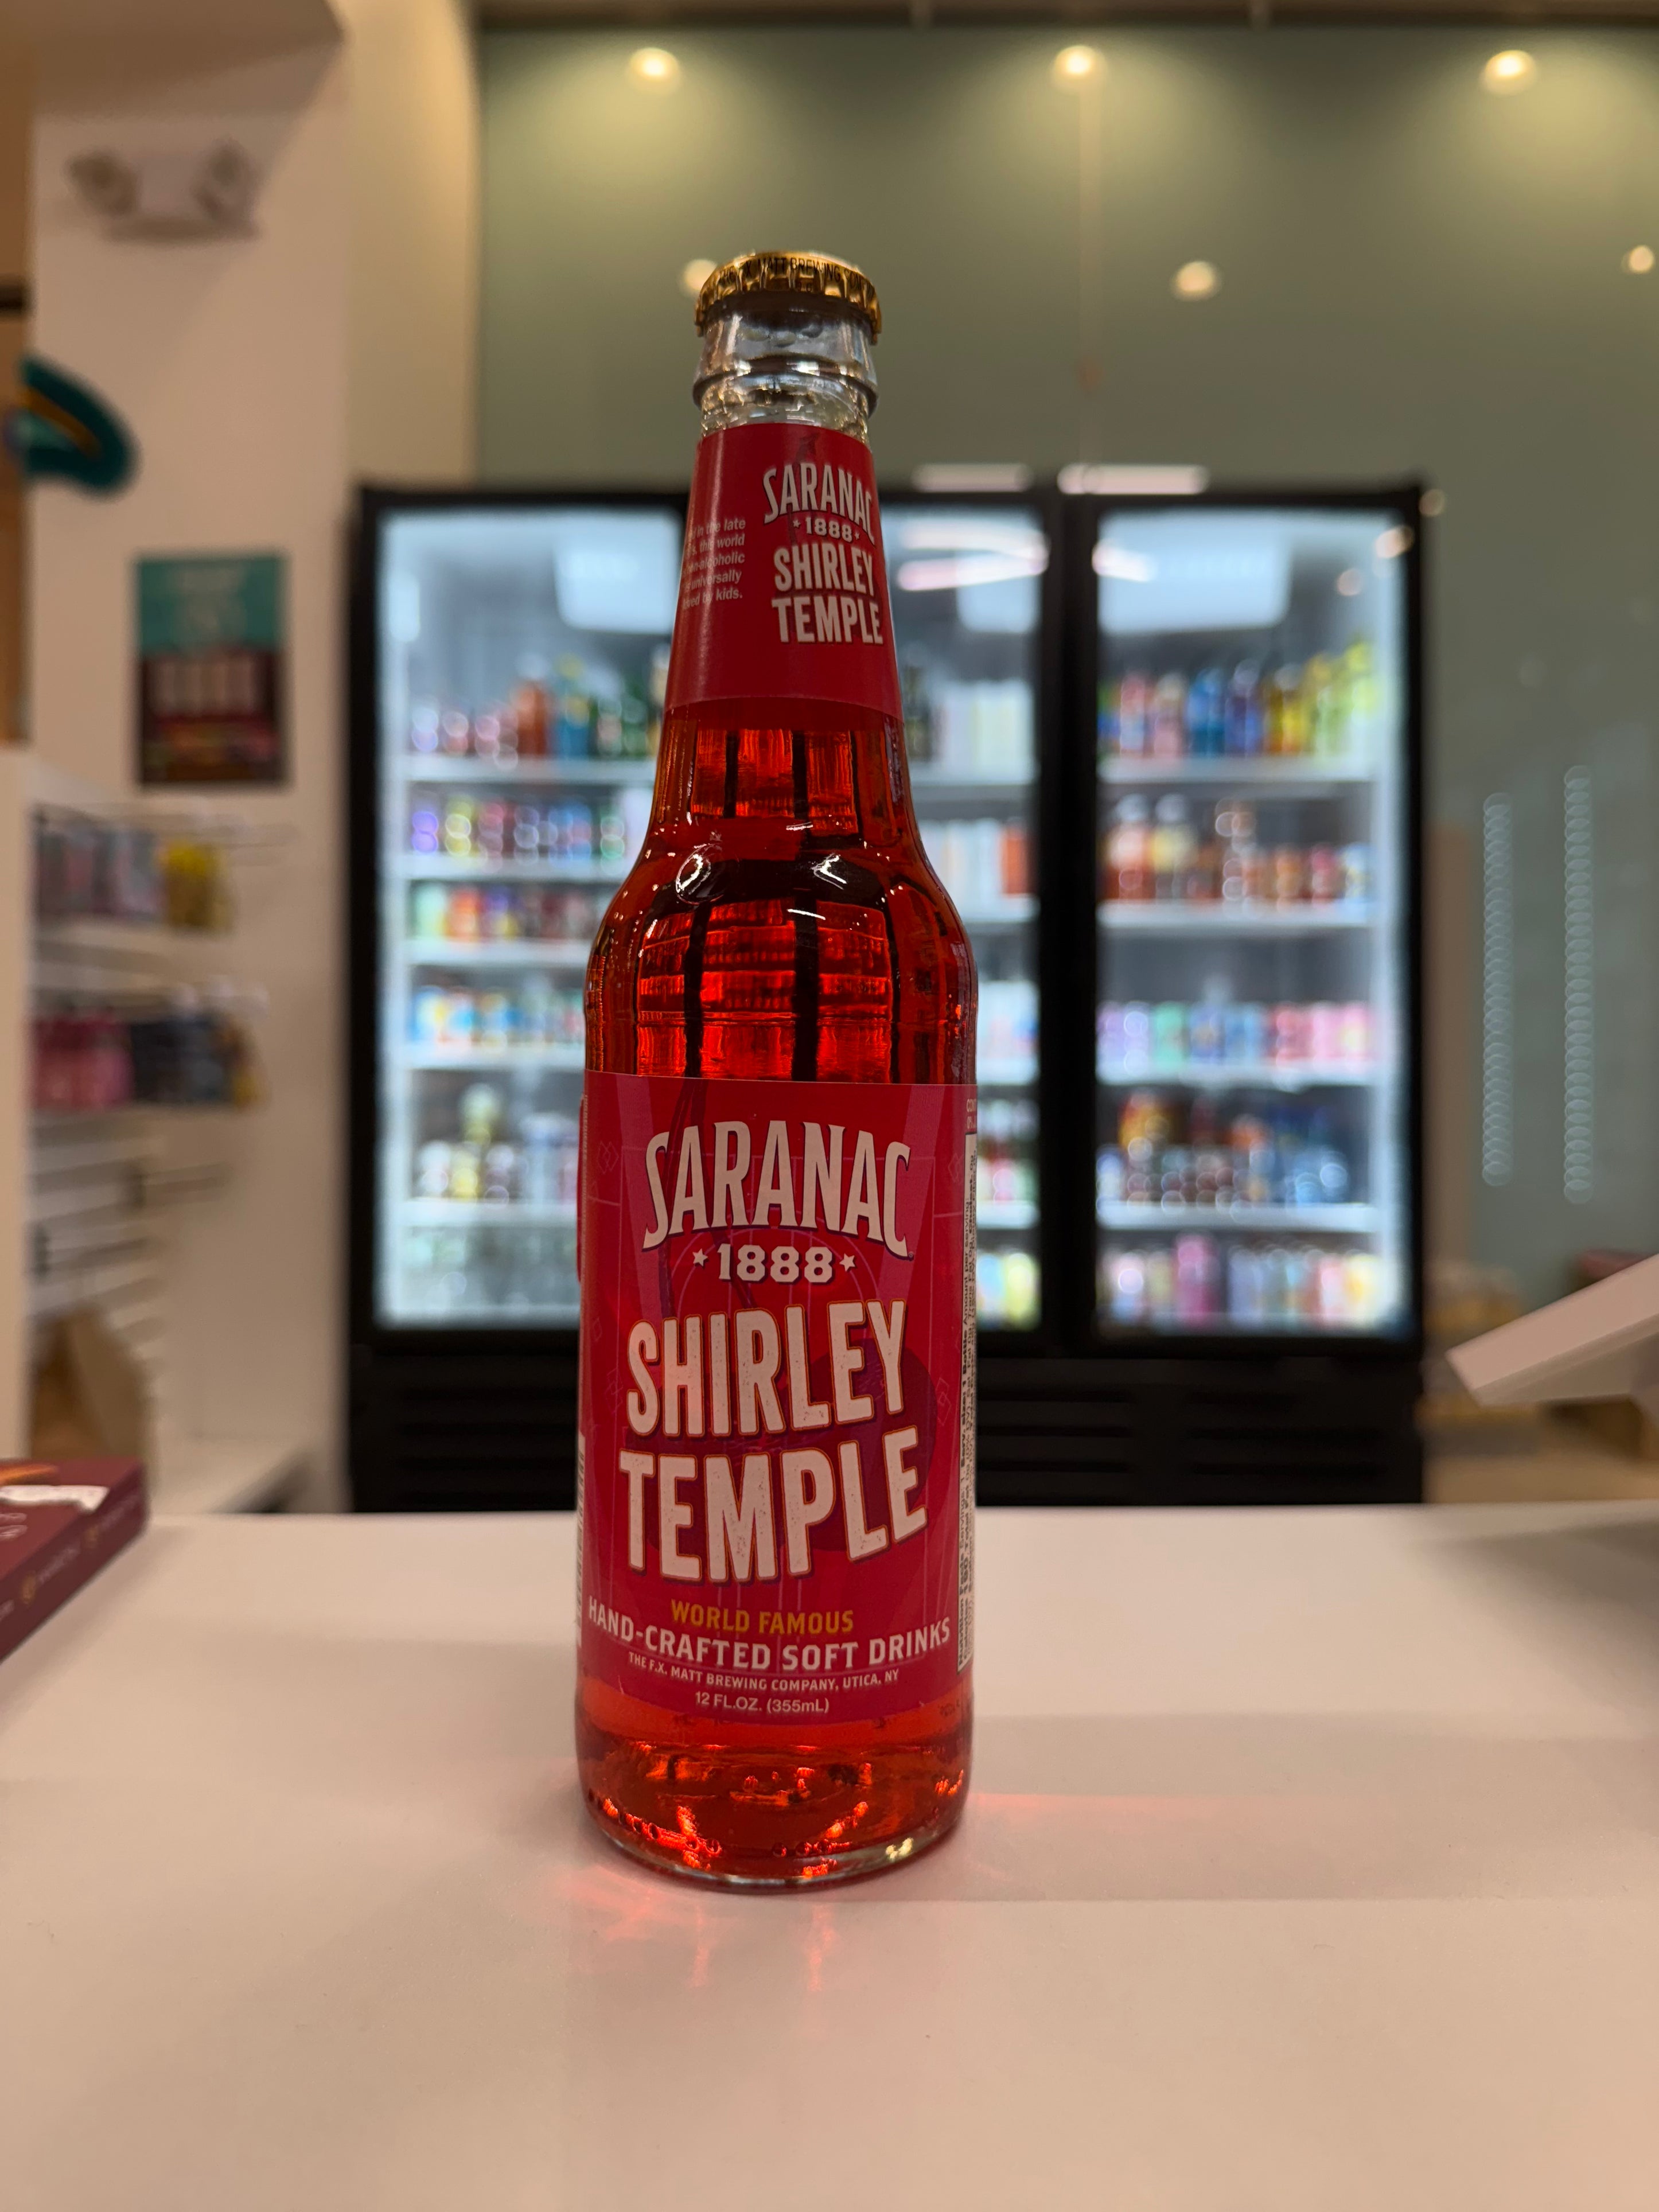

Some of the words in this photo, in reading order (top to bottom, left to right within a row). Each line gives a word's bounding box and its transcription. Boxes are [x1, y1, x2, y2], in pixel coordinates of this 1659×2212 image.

[790, 257, 840, 282] BREWING
[724, 517, 746, 531] late
[763, 462, 875, 546] SARANAC
[717, 533, 745, 548] world
[805, 517, 852, 543] 1888
[691, 570, 742, 590] universally
[773, 542, 874, 597] SHIRLEY
[716, 587, 743, 601] kids.
[772, 595, 883, 644] TEMPLE
[642, 1120, 911, 1259] SARANAC
[718, 1243, 835, 1284] 1888
[625, 1299, 908, 1438] SHIRLEY
[618, 1425, 929, 1583] TEMPLE
[589, 1595, 771, 1670] HAND-CRAFTED
[782, 1642, 859, 1671] SOFT
[869, 1616, 951, 1666] DRINKS
[671, 1598, 750, 1632] WORLD
[759, 1610, 854, 1634] FAMOUS
[629, 1651, 647, 1667] THE
[649, 1658, 667, 1675] F.X.
[671, 1665, 703, 1684] MATT
[706, 1673, 767, 1690] BREWING
[772, 1678, 839, 1692] COMPANY,
[884, 1668, 899, 1683] NY
[695, 1691, 710, 1706] 12
[714, 1693, 762, 1712] FL.OZ.
[766, 1697, 829, 1714] (355mL)
